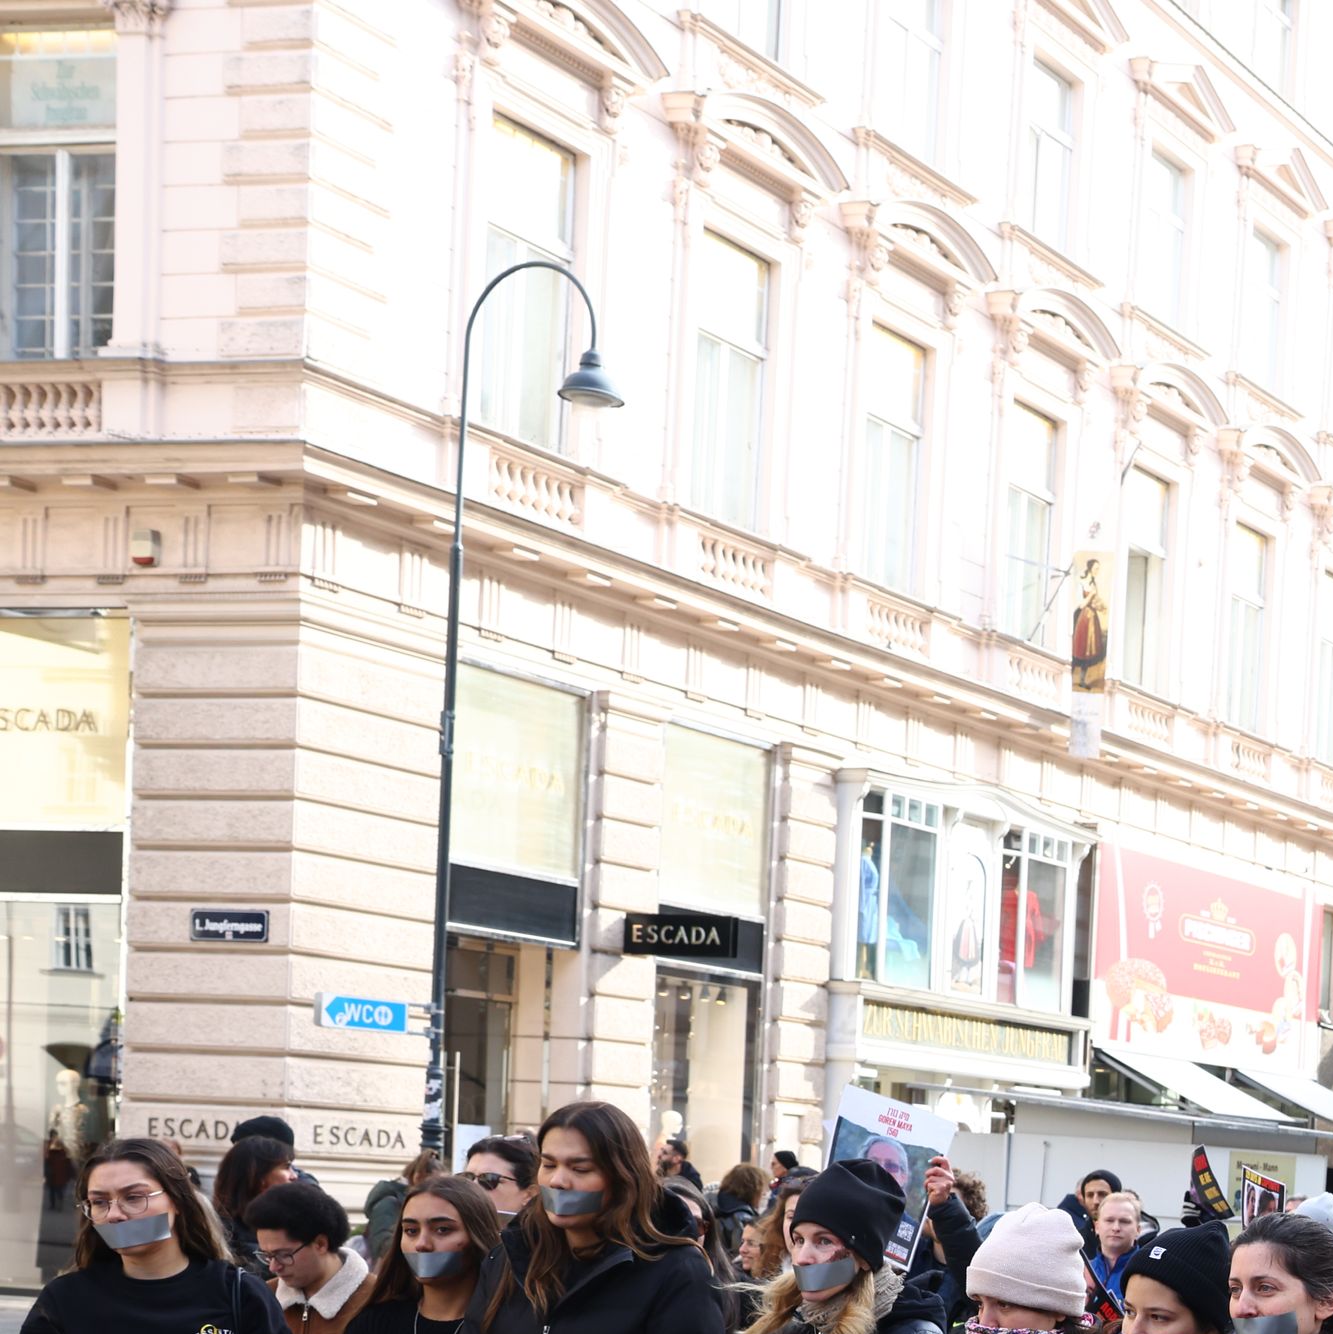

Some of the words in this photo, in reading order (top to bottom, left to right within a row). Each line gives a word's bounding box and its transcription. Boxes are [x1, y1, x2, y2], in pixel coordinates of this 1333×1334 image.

[631, 924, 721, 946] ESCADA
[344, 1002, 373, 1023] WC
[878, 1114, 897, 1128] GOREN
[897, 1119, 913, 1132] MAYA
[313, 1124, 406, 1149] ESCADA
